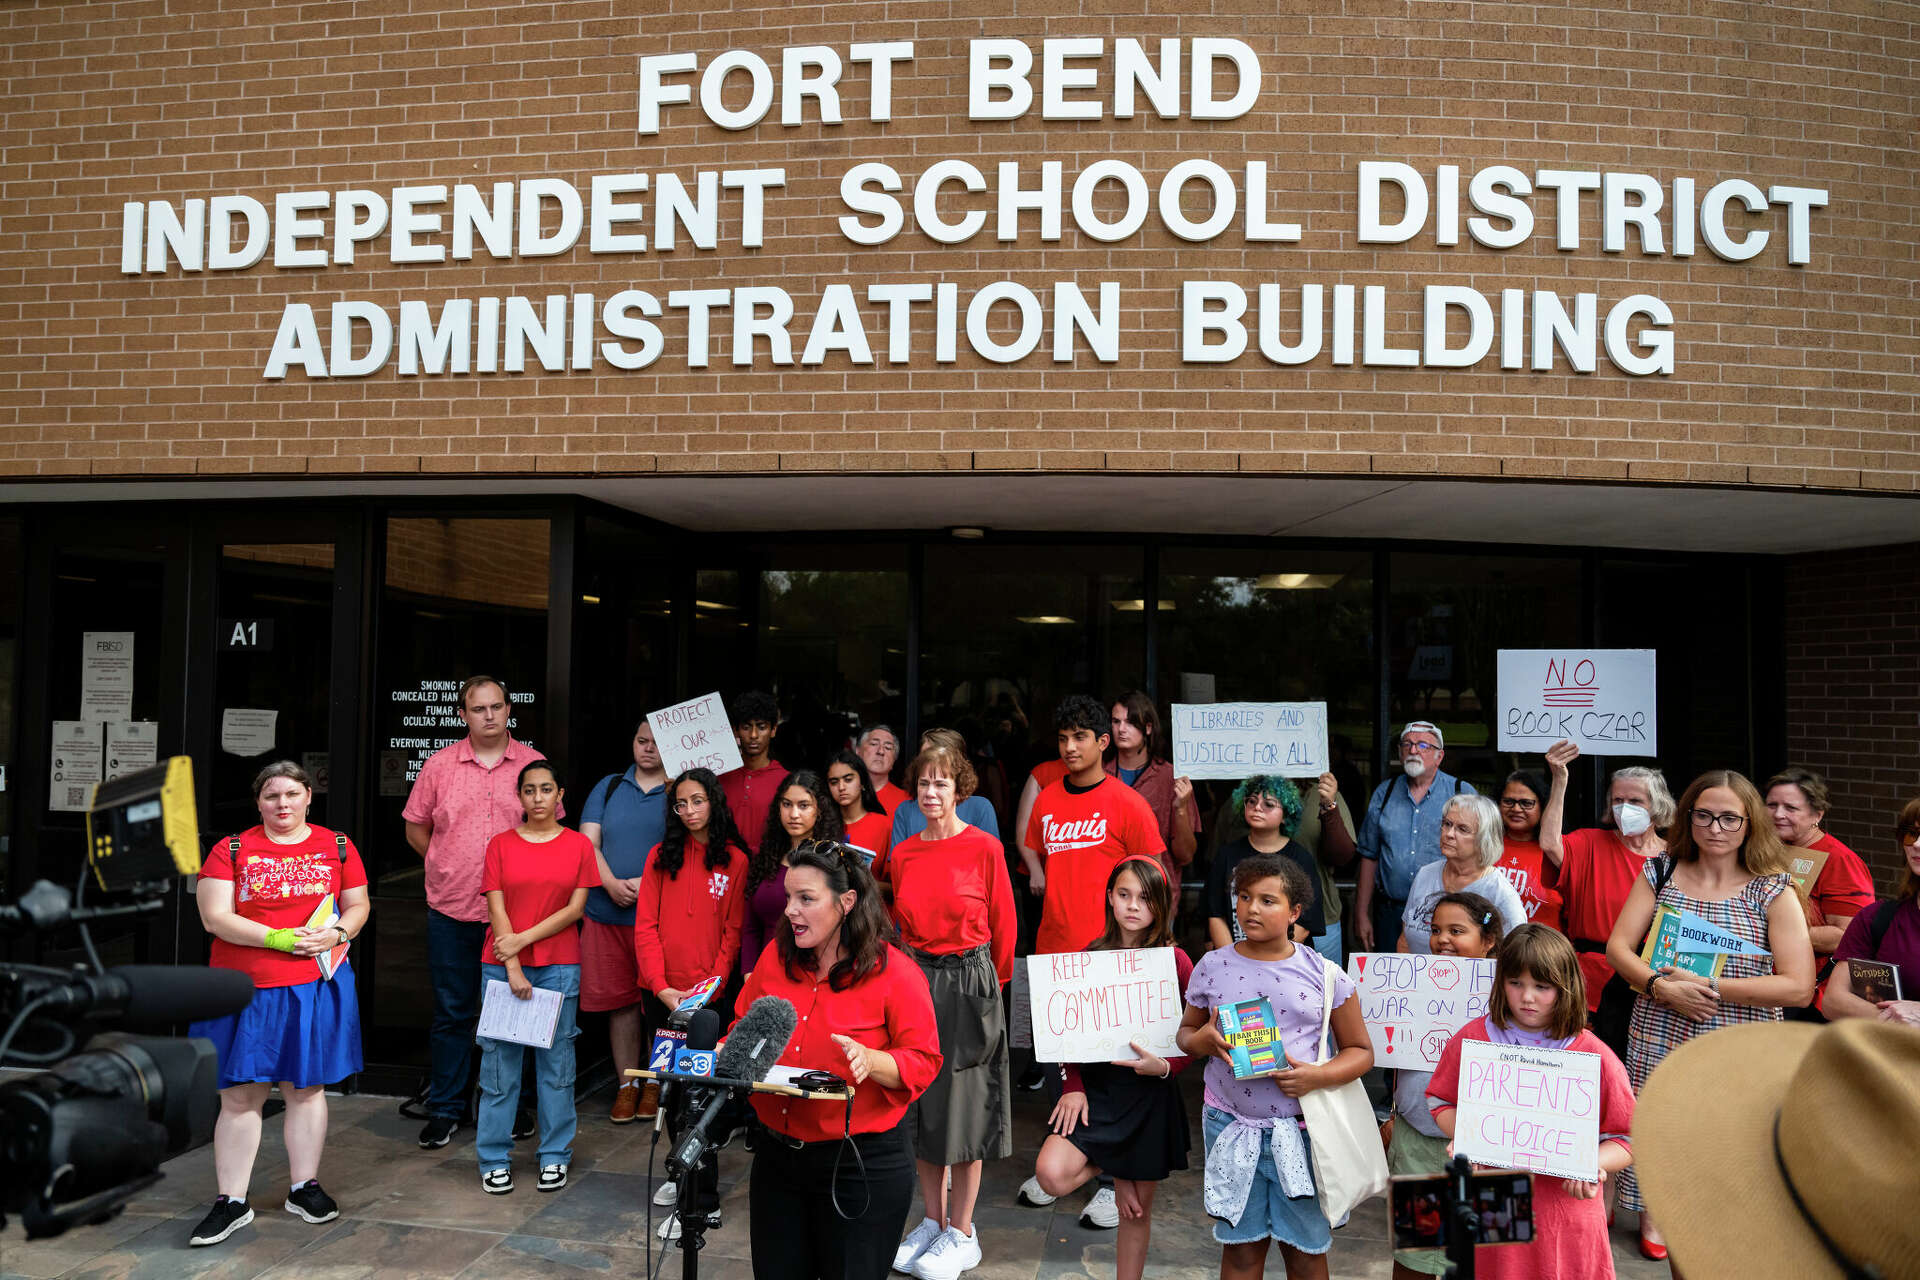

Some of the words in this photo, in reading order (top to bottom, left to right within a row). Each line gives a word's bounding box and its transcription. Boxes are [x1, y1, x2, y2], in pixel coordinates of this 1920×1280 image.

[637, 41, 914, 135] FORT
[968, 36, 1262, 121] BEND
[121, 167, 786, 275] INDEPENDENT
[838, 158, 1302, 246] SCHOOL
[1357, 160, 1829, 266] DISTRICT
[263, 281, 1120, 380] ADMINISTRATION
[1182, 280, 1675, 376] BUILDING
[230, 622, 257, 645] A1
[1545, 657, 1597, 687] NO
[392, 691, 438, 701] CONCEALED
[421, 680, 457, 690] SMOKING
[403, 716, 436, 726] OCULTAS
[440, 716, 467, 727] ARMAS
[425, 705, 453, 715] FUMAR
[655, 697, 713, 729] PROTECT
[1191, 710, 1264, 729] LIBRARIES
[1277, 709, 1305, 728] AND
[1506, 707, 1574, 737] BOOK
[1580, 710, 1647, 741] CZAR
[390, 738, 431, 748] EVERYONE
[680, 729, 710, 751] OUR
[1179, 740, 1245, 763] JUSTICE
[1253, 742, 1279, 764] FOR
[1287, 741, 1314, 765] ALL
[408, 760, 423, 770] THE
[1041, 812, 1107, 844] Travis
[1681, 926, 1744, 953] BOOKWORM
[1051, 951, 1091, 982] KEEP
[1112, 950, 1144, 976] THE
[1373, 955, 1428, 990] STOP
[1465, 958, 1497, 993] TH
[1047, 980, 1173, 1036] COMMITTEE
[1360, 996, 1414, 1019] WAR
[1427, 999, 1455, 1016] ON
[656, 1028, 676, 1038] KPRC
[1237, 1031, 1252, 1040] BAN
[1253, 1028, 1270, 1038] THIS
[1245, 1036, 1264, 1045] BOOK
[649, 1040, 673, 1068] 2
[694, 1059, 707, 1071] 13
[1480, 1114, 1577, 1156] CHOICE
